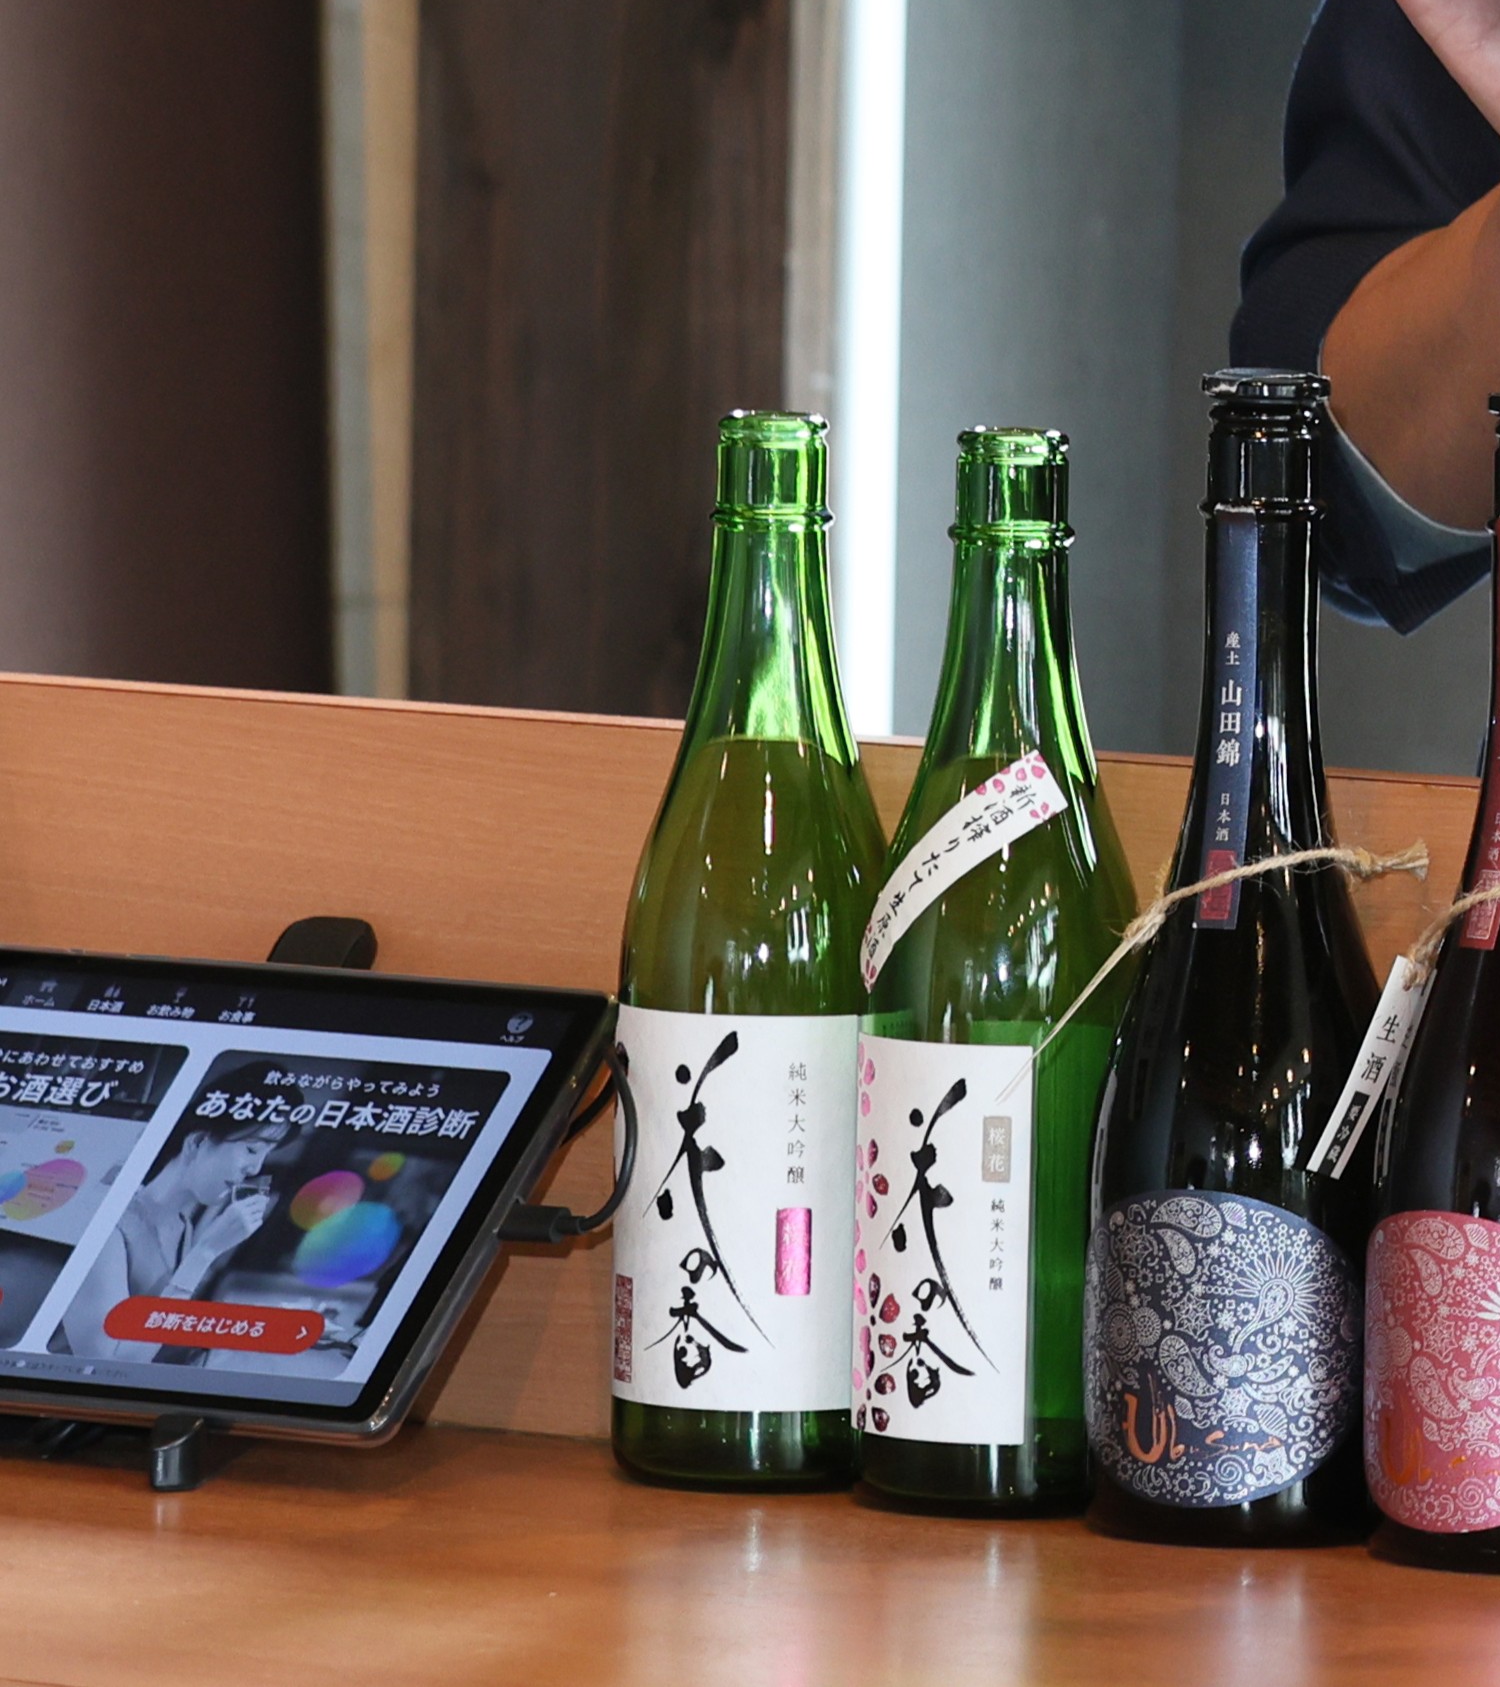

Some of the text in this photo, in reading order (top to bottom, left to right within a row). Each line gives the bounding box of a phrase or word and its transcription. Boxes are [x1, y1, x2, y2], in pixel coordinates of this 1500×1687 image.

[1223, 630, 1241, 668] 産土
[1215, 678, 1244, 770] 山田錦
[1214, 791, 1231, 843] 日本酒
[21, 993, 56, 1008] ホーム
[86, 999, 126, 1014] 日本酒
[146, 1004, 196, 1021] お飲み物
[217, 1009, 257, 1025] お食事
[0, 1048, 145, 1074] にあわせておすすめ
[1358, 1012, 1402, 1086] 生酒
[263, 1067, 442, 1099] 飲みながらやってみよう
[194, 1086, 481, 1143] あなたの日本酒診断
[786, 1061, 808, 1186] 純米大吟醸
[643, 1031, 775, 1389] 花の香
[879, 1077, 1000, 1408] 花の香
[988, 1197, 1006, 1294] 純米大吟醸
[144, 1311, 267, 1338] 診断をはじめる
